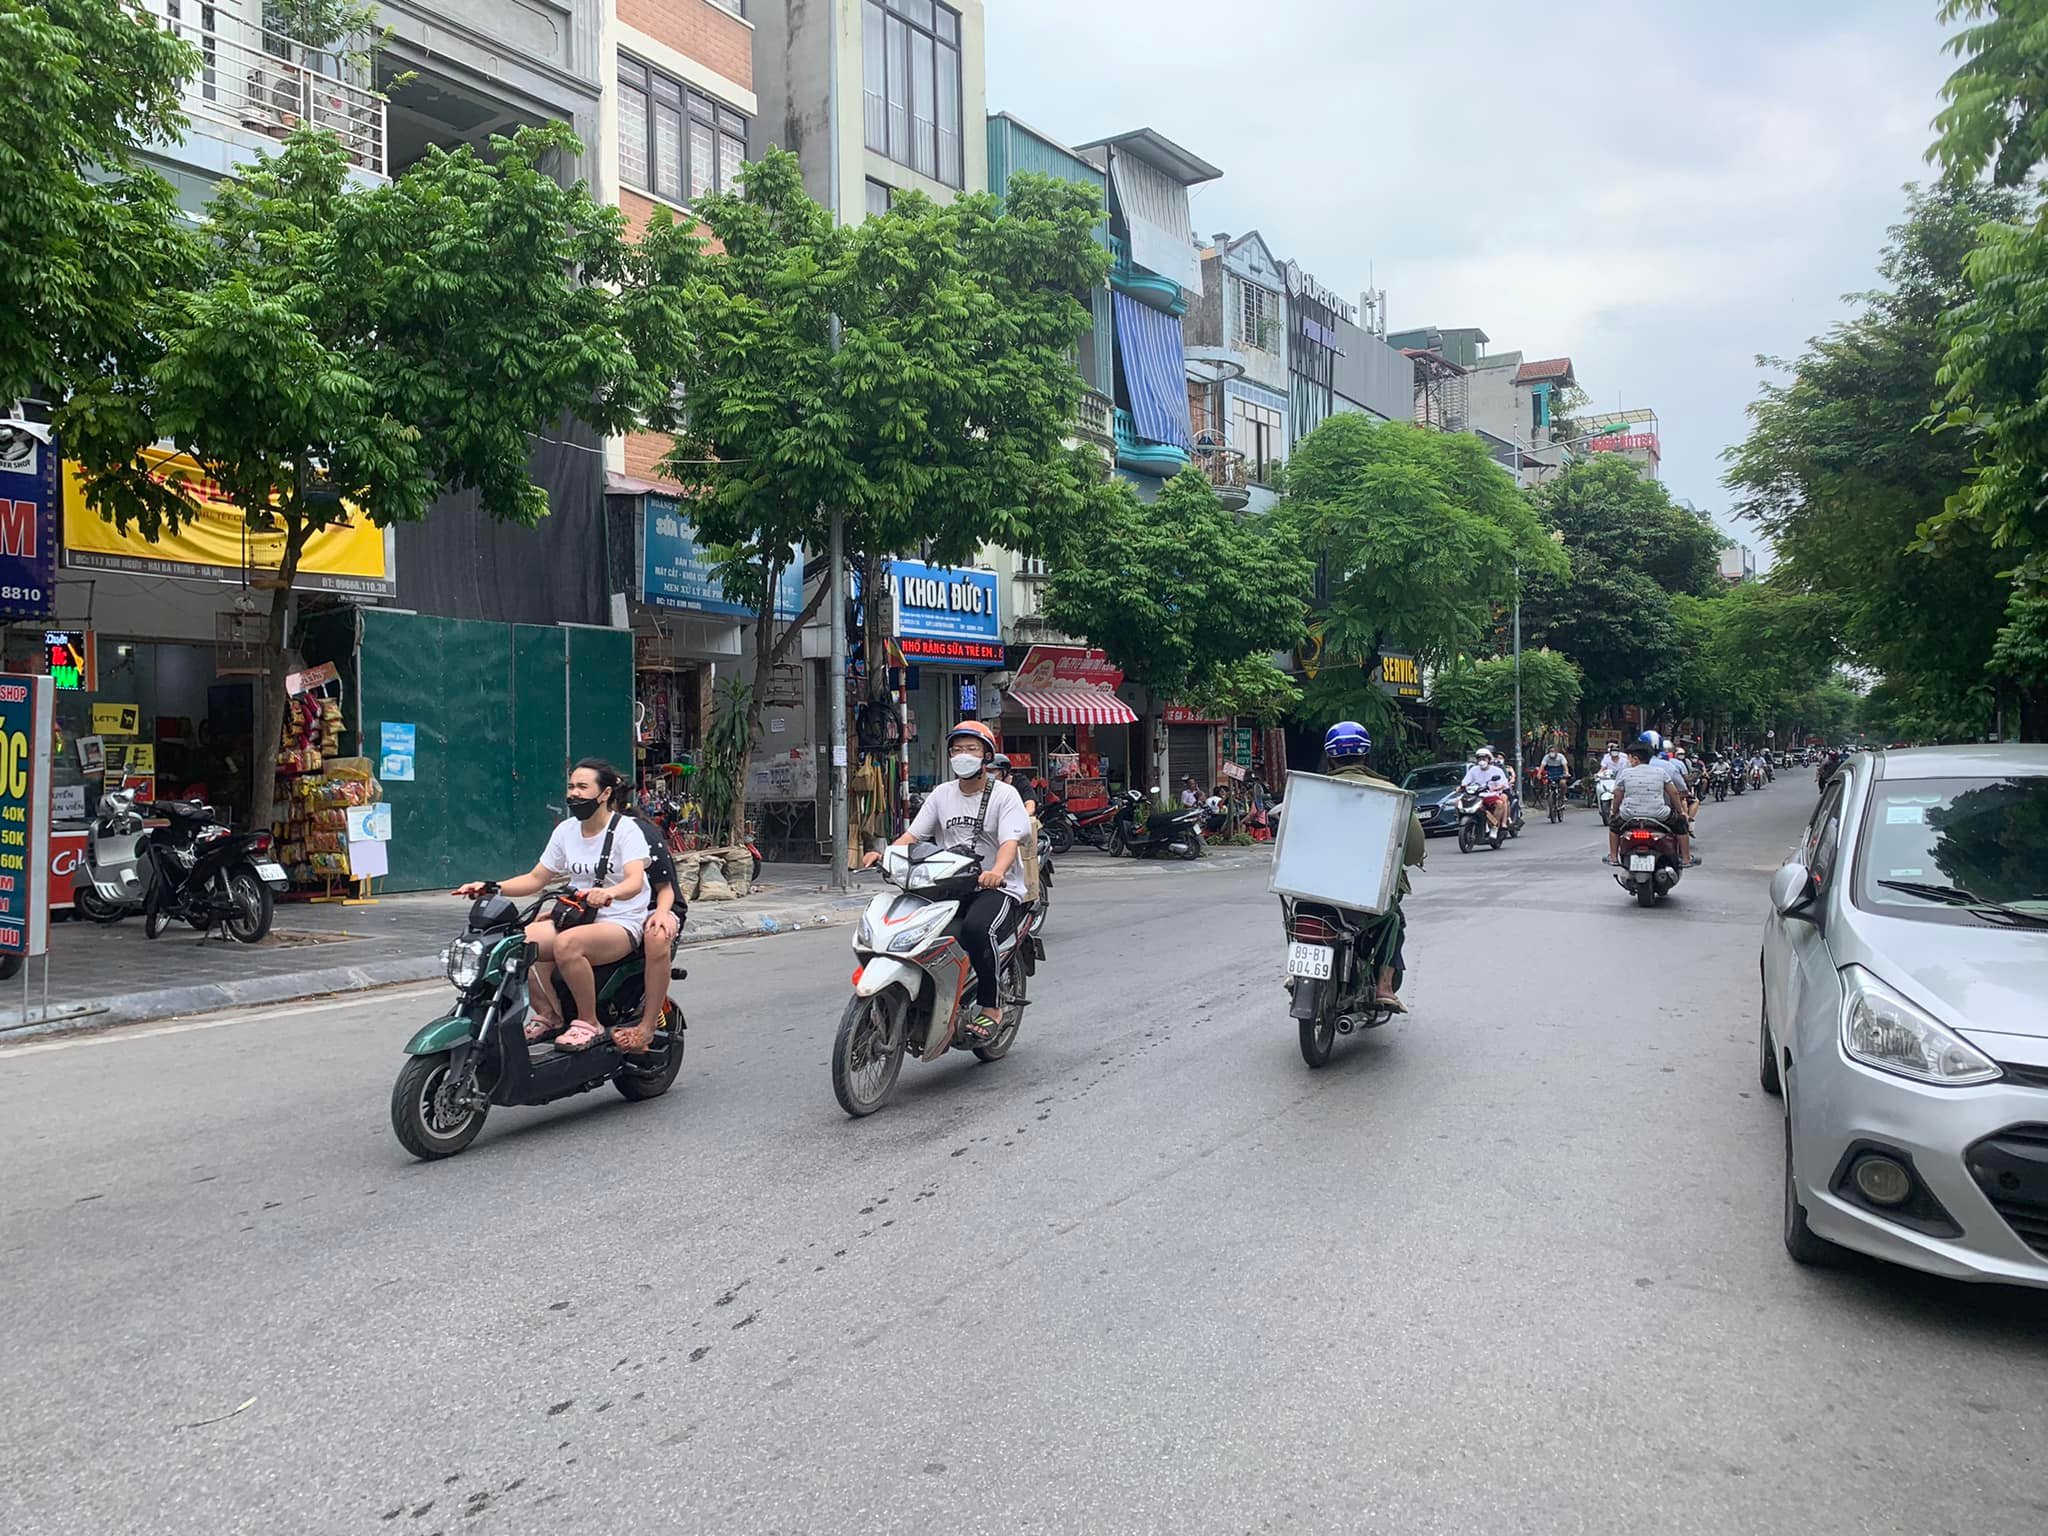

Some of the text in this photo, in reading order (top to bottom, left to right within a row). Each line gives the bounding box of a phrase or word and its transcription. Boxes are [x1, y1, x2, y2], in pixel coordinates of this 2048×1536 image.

[1, 586, 41, 601] 8810
[904, 576, 948, 609] KHOA
[951, 576, 982, 614] ĐỨC
[1383, 656, 1419, 684] SERVICE
[0, 685, 27, 702] SHOP
[2, 806, 25, 822] 40K
[1, 830, 25, 846] 50K
[0, 853, 24, 870] 60K
[1295, 945, 1327, 962] 89-B1
[1289, 959, 1329, 977] 804.69
